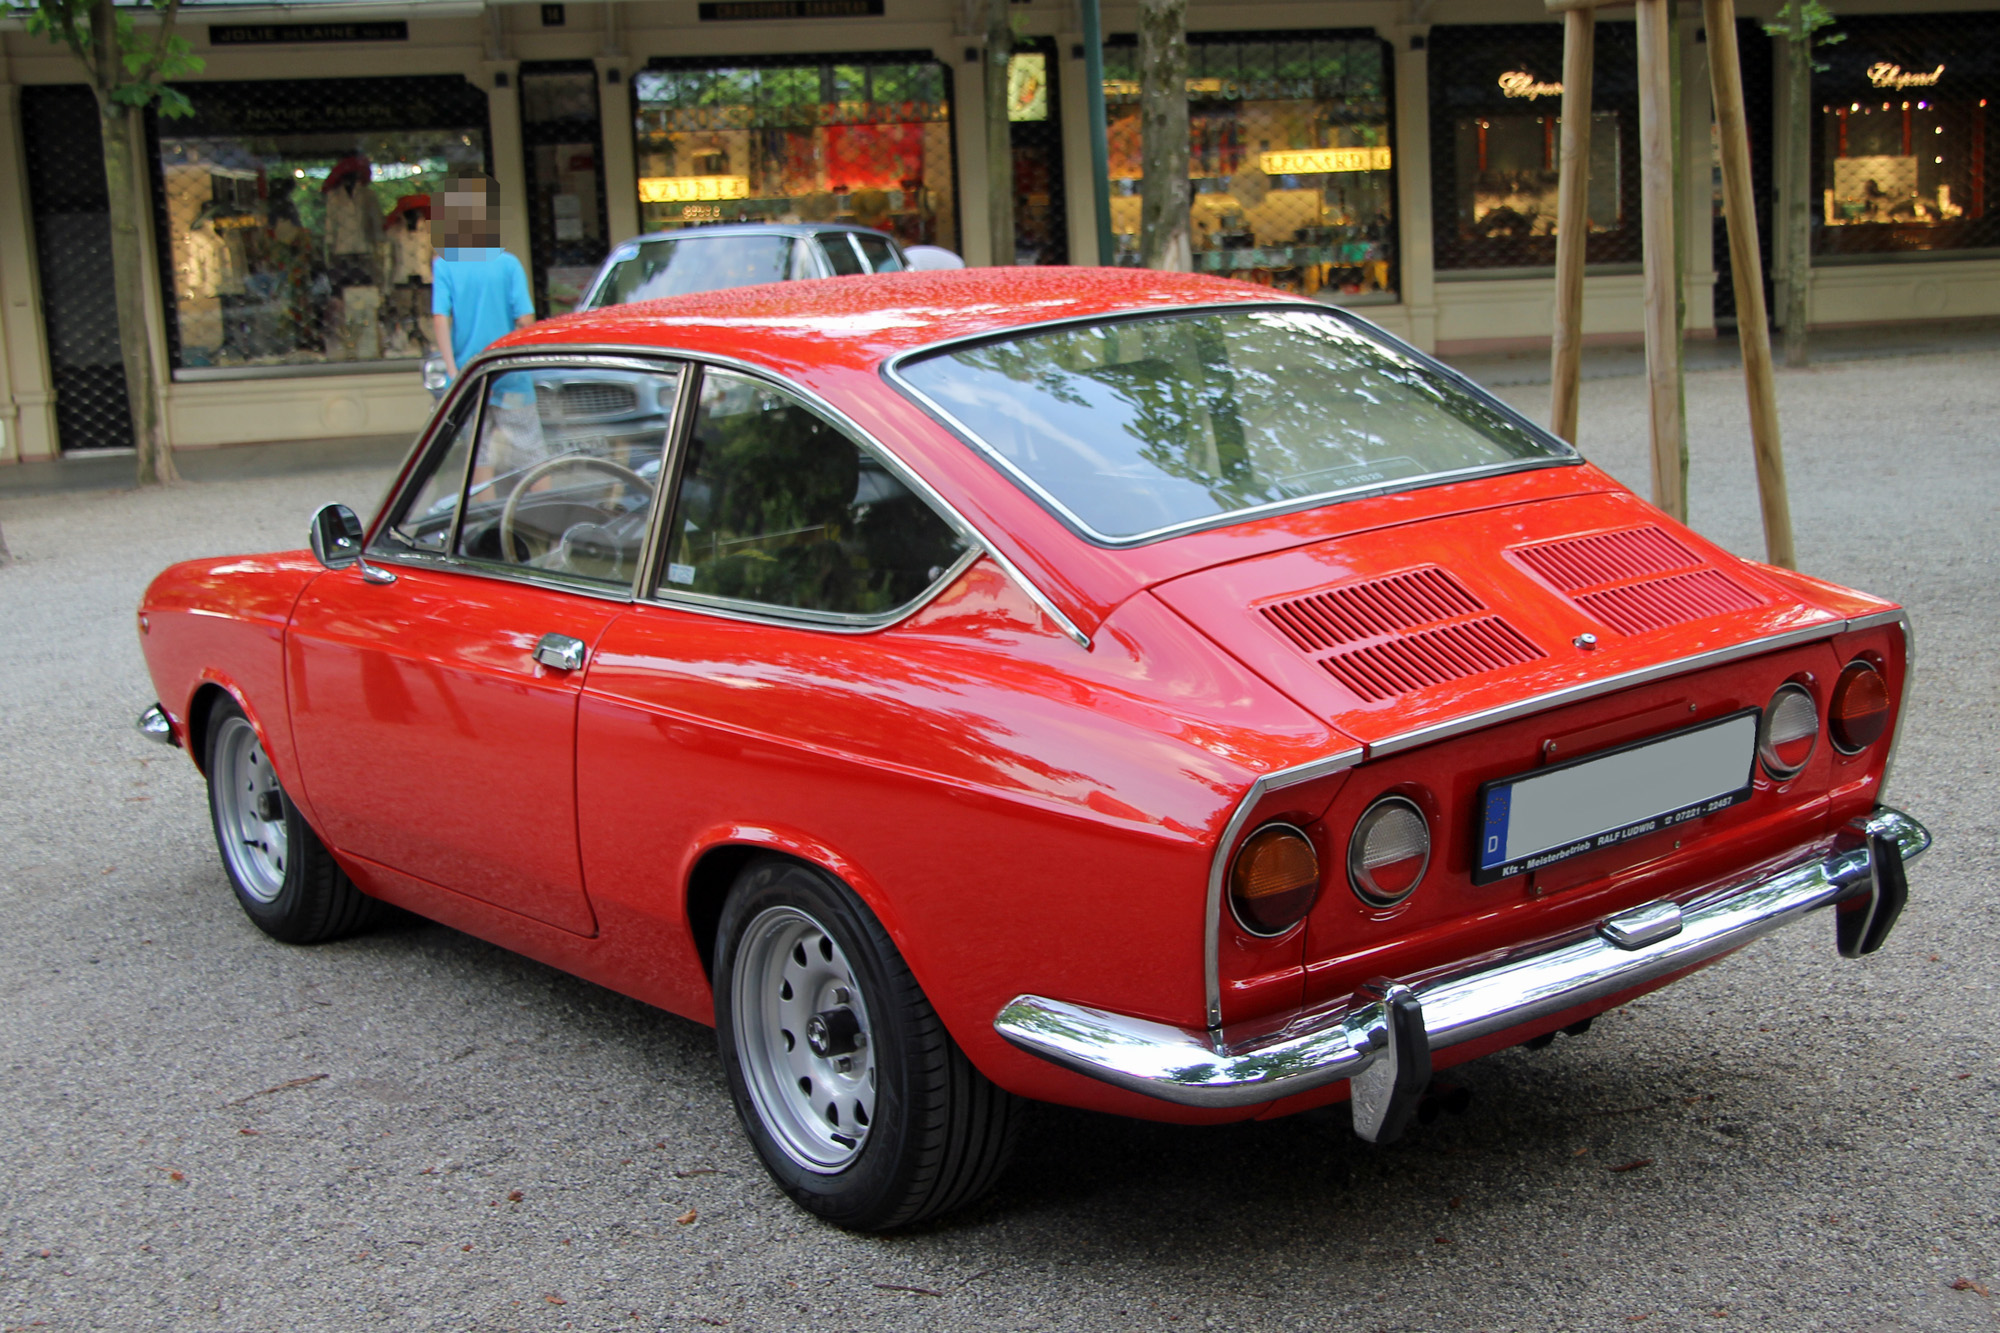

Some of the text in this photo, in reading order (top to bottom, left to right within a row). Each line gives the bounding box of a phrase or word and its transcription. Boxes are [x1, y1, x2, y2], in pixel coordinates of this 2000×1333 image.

[220, 29, 275, 41] JOLIE
[301, 27, 357, 40] LAINE
[1497, 71, 1565, 102] Chopar
[1866, 62, 1946, 92] Chopard
[1487, 835, 1499, 853] D
[1502, 865, 1519, 877] Kfz
[1526, 841, 1591, 869] Meisterbetrieb
[1597, 830, 1620, 846] RALF
[1621, 821, 1656, 839] LUDWIG
[1675, 806, 1701, 822] 07221
